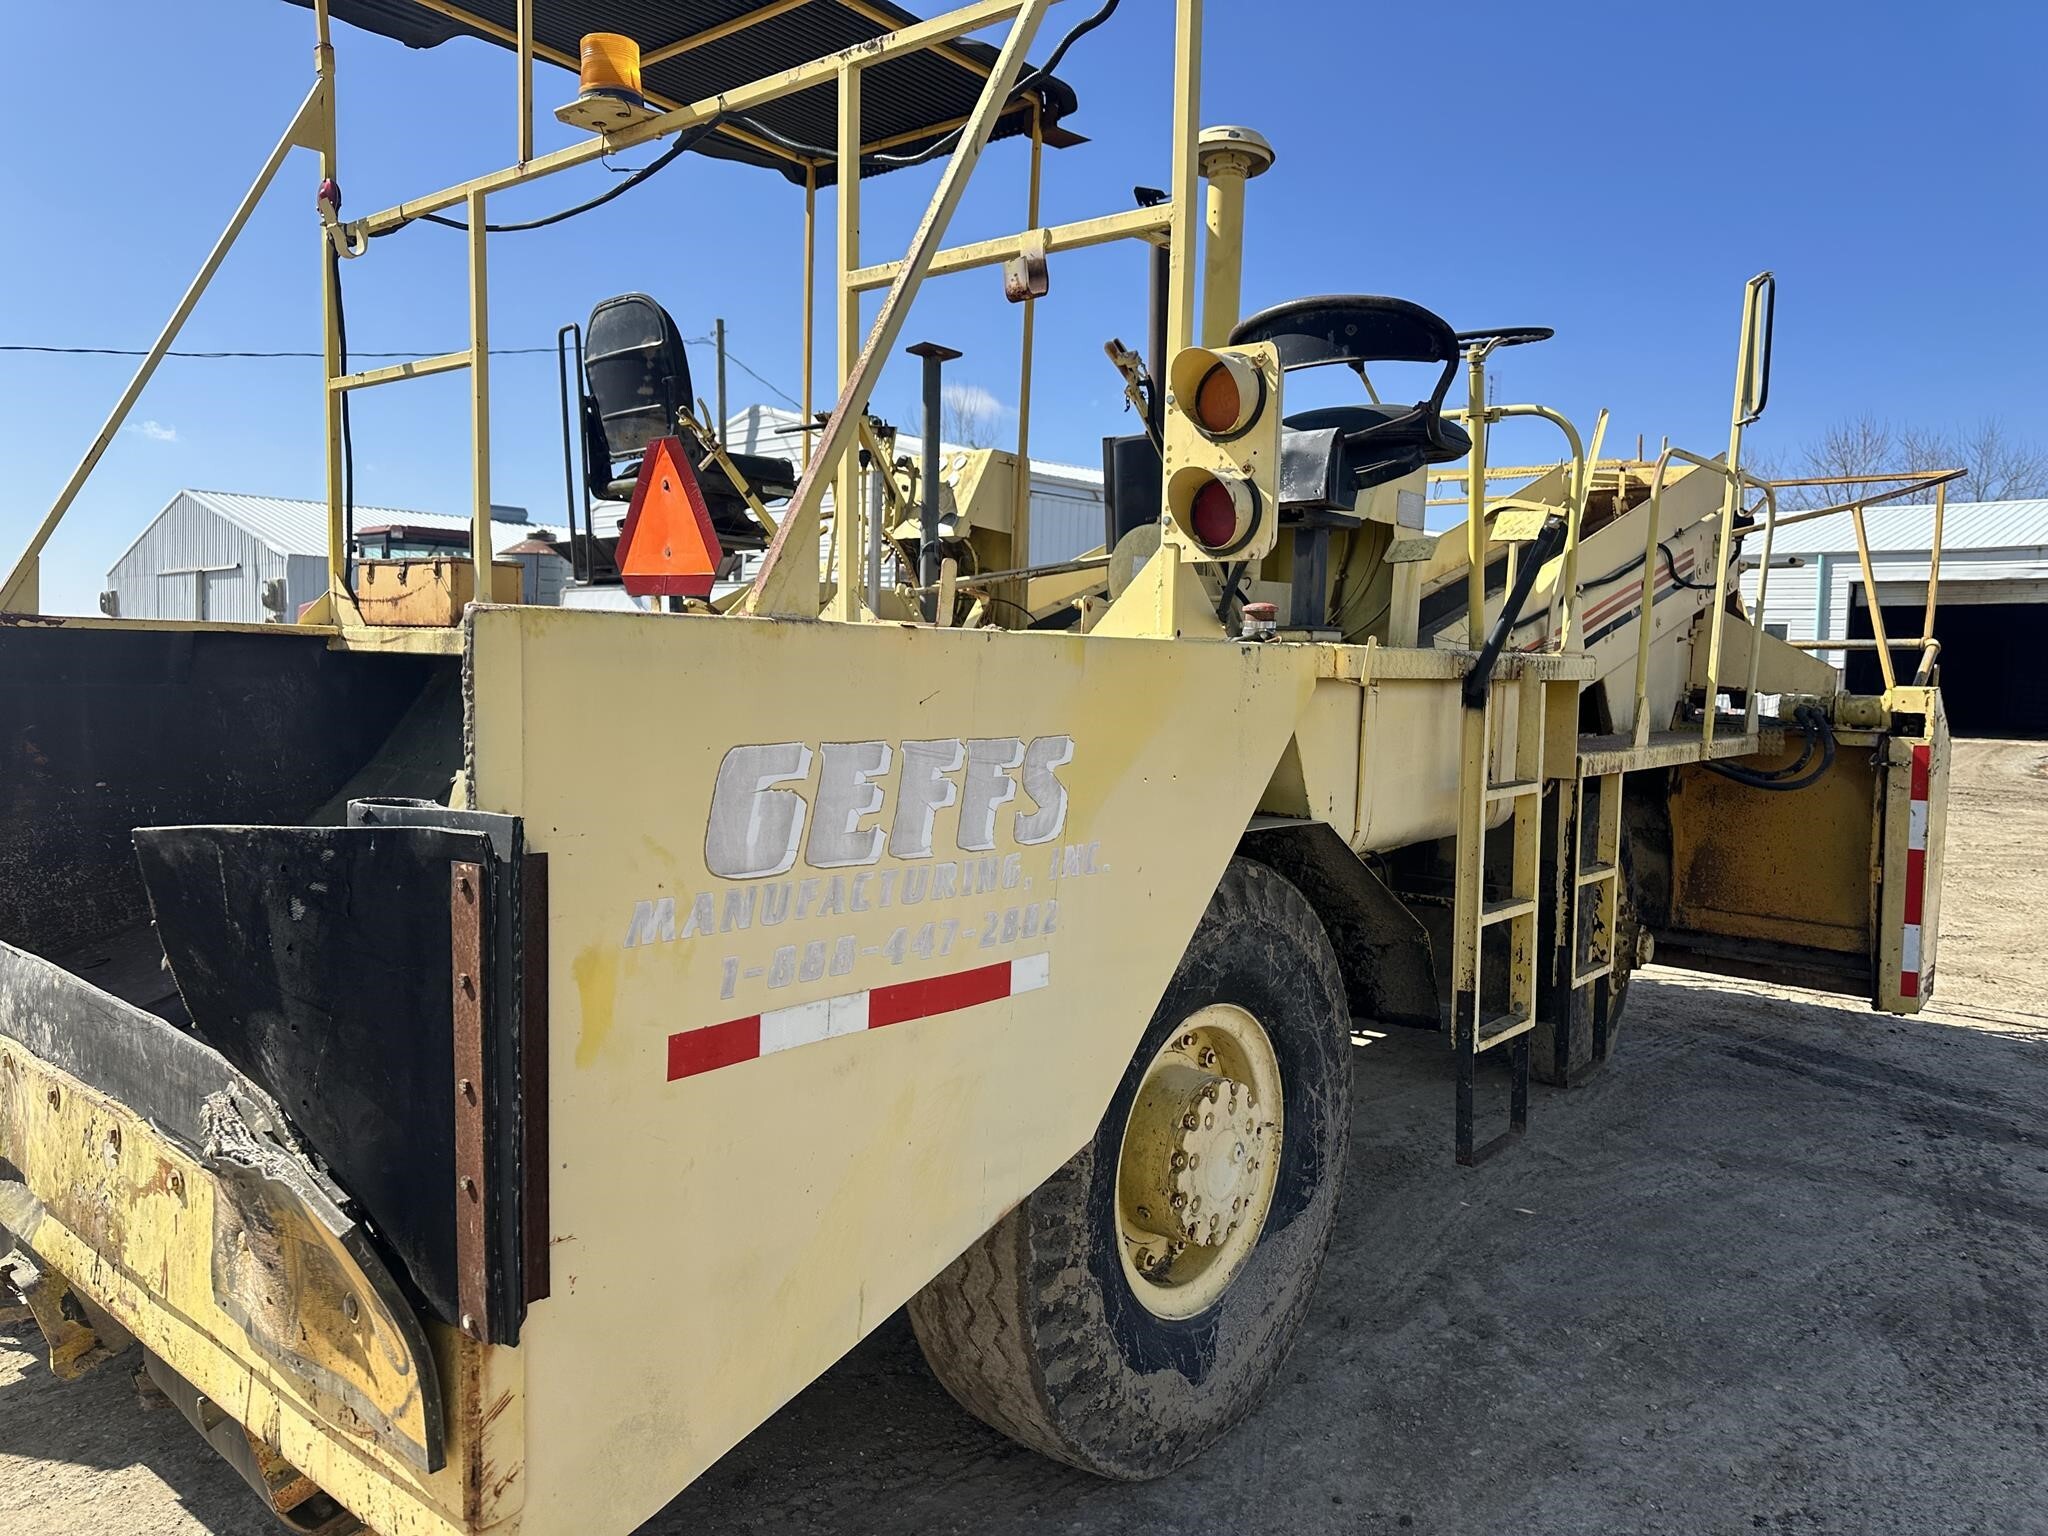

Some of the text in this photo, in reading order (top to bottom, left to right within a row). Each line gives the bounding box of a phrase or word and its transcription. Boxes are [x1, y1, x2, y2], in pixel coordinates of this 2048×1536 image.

[705, 734, 1075, 880] GEFFS
[624, 841, 1111, 948] MANUFACTURING, INC.
